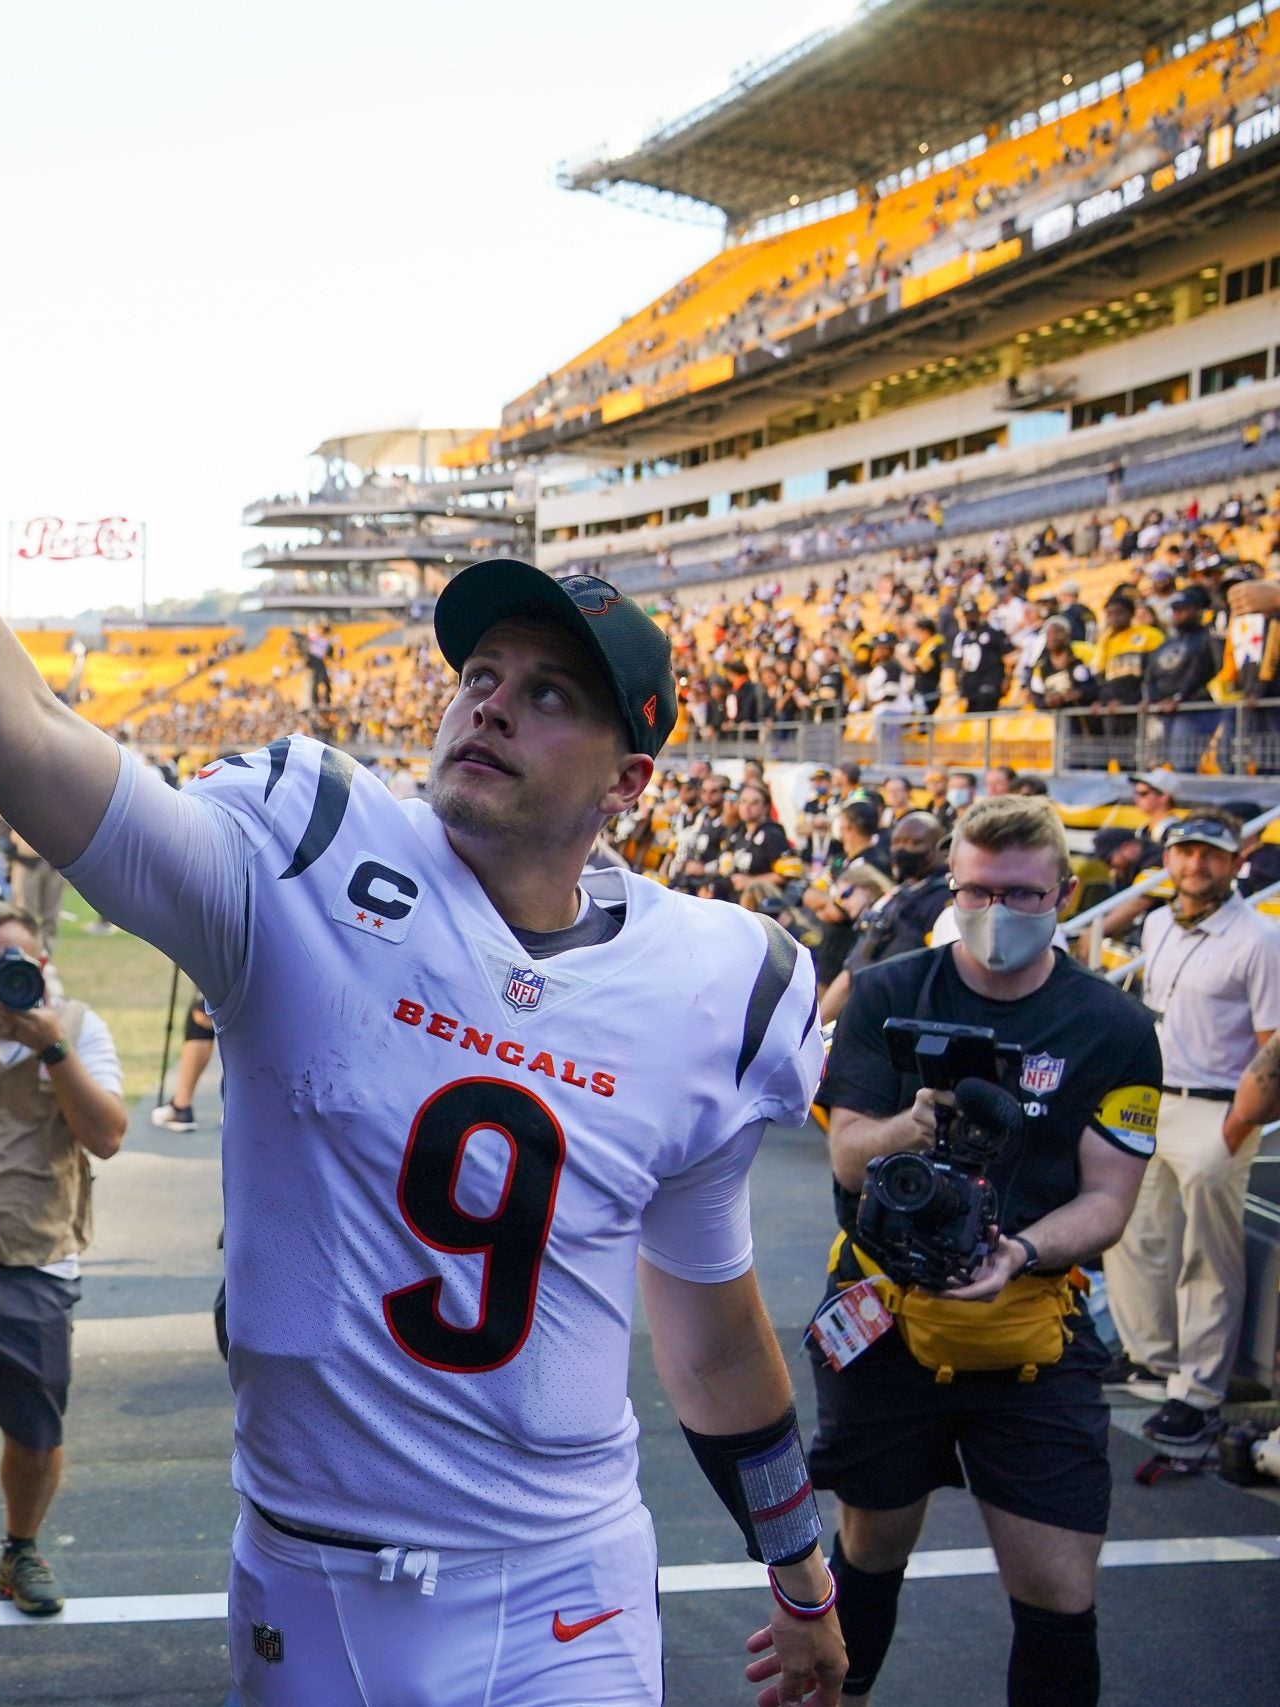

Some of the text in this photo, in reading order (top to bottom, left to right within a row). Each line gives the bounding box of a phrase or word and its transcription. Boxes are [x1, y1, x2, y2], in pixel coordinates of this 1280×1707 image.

[347, 860, 419, 921] C
[508, 980, 537, 1005] NFL
[393, 997, 616, 1098] BENGALS
[1025, 1070, 1055, 1089] NFL
[1120, 1108, 1154, 1129] WEEK
[382, 1075, 567, 1374] 9
